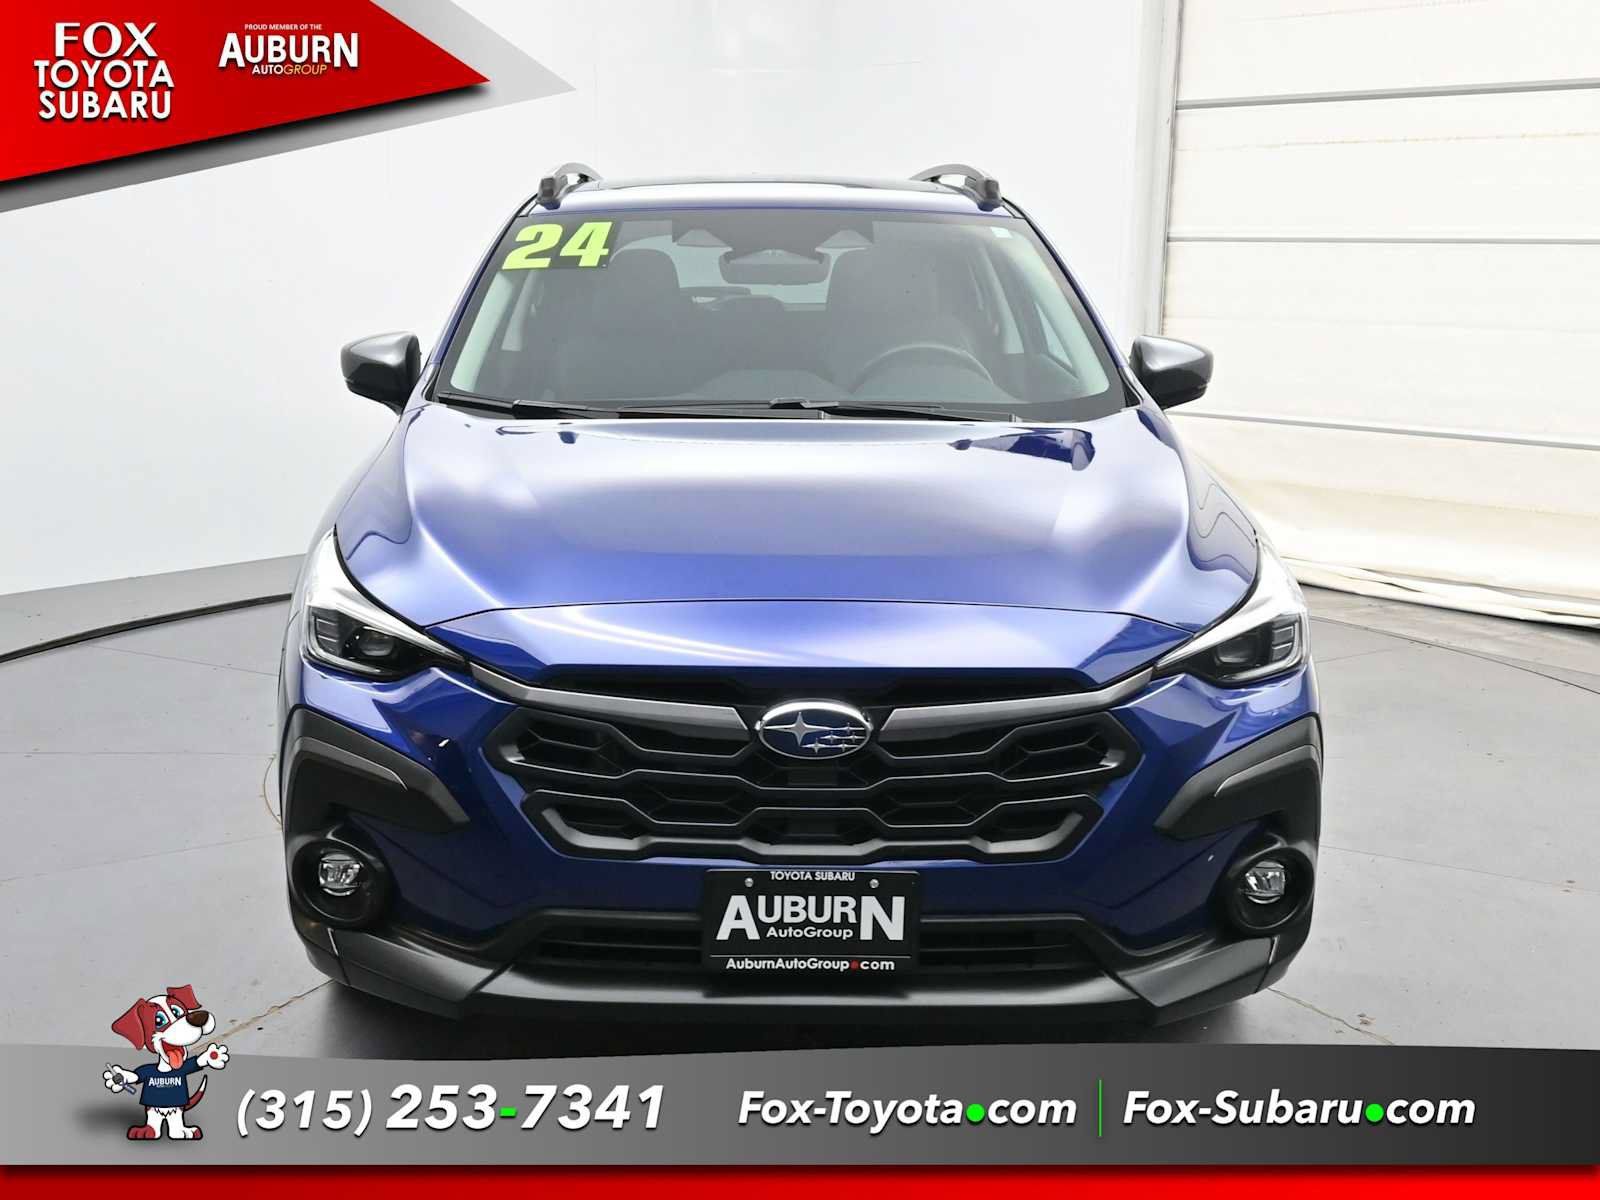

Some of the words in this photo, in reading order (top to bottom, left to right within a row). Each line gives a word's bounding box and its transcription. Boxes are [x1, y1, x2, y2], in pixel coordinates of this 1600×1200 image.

[501, 222, 613, 270] 24
[770, 871, 812, 881] TOYOTA
[815, 871, 856, 882] SUBARU
[716, 895, 905, 941] AUBURN
[766, 926, 854, 941] AutoGroup
